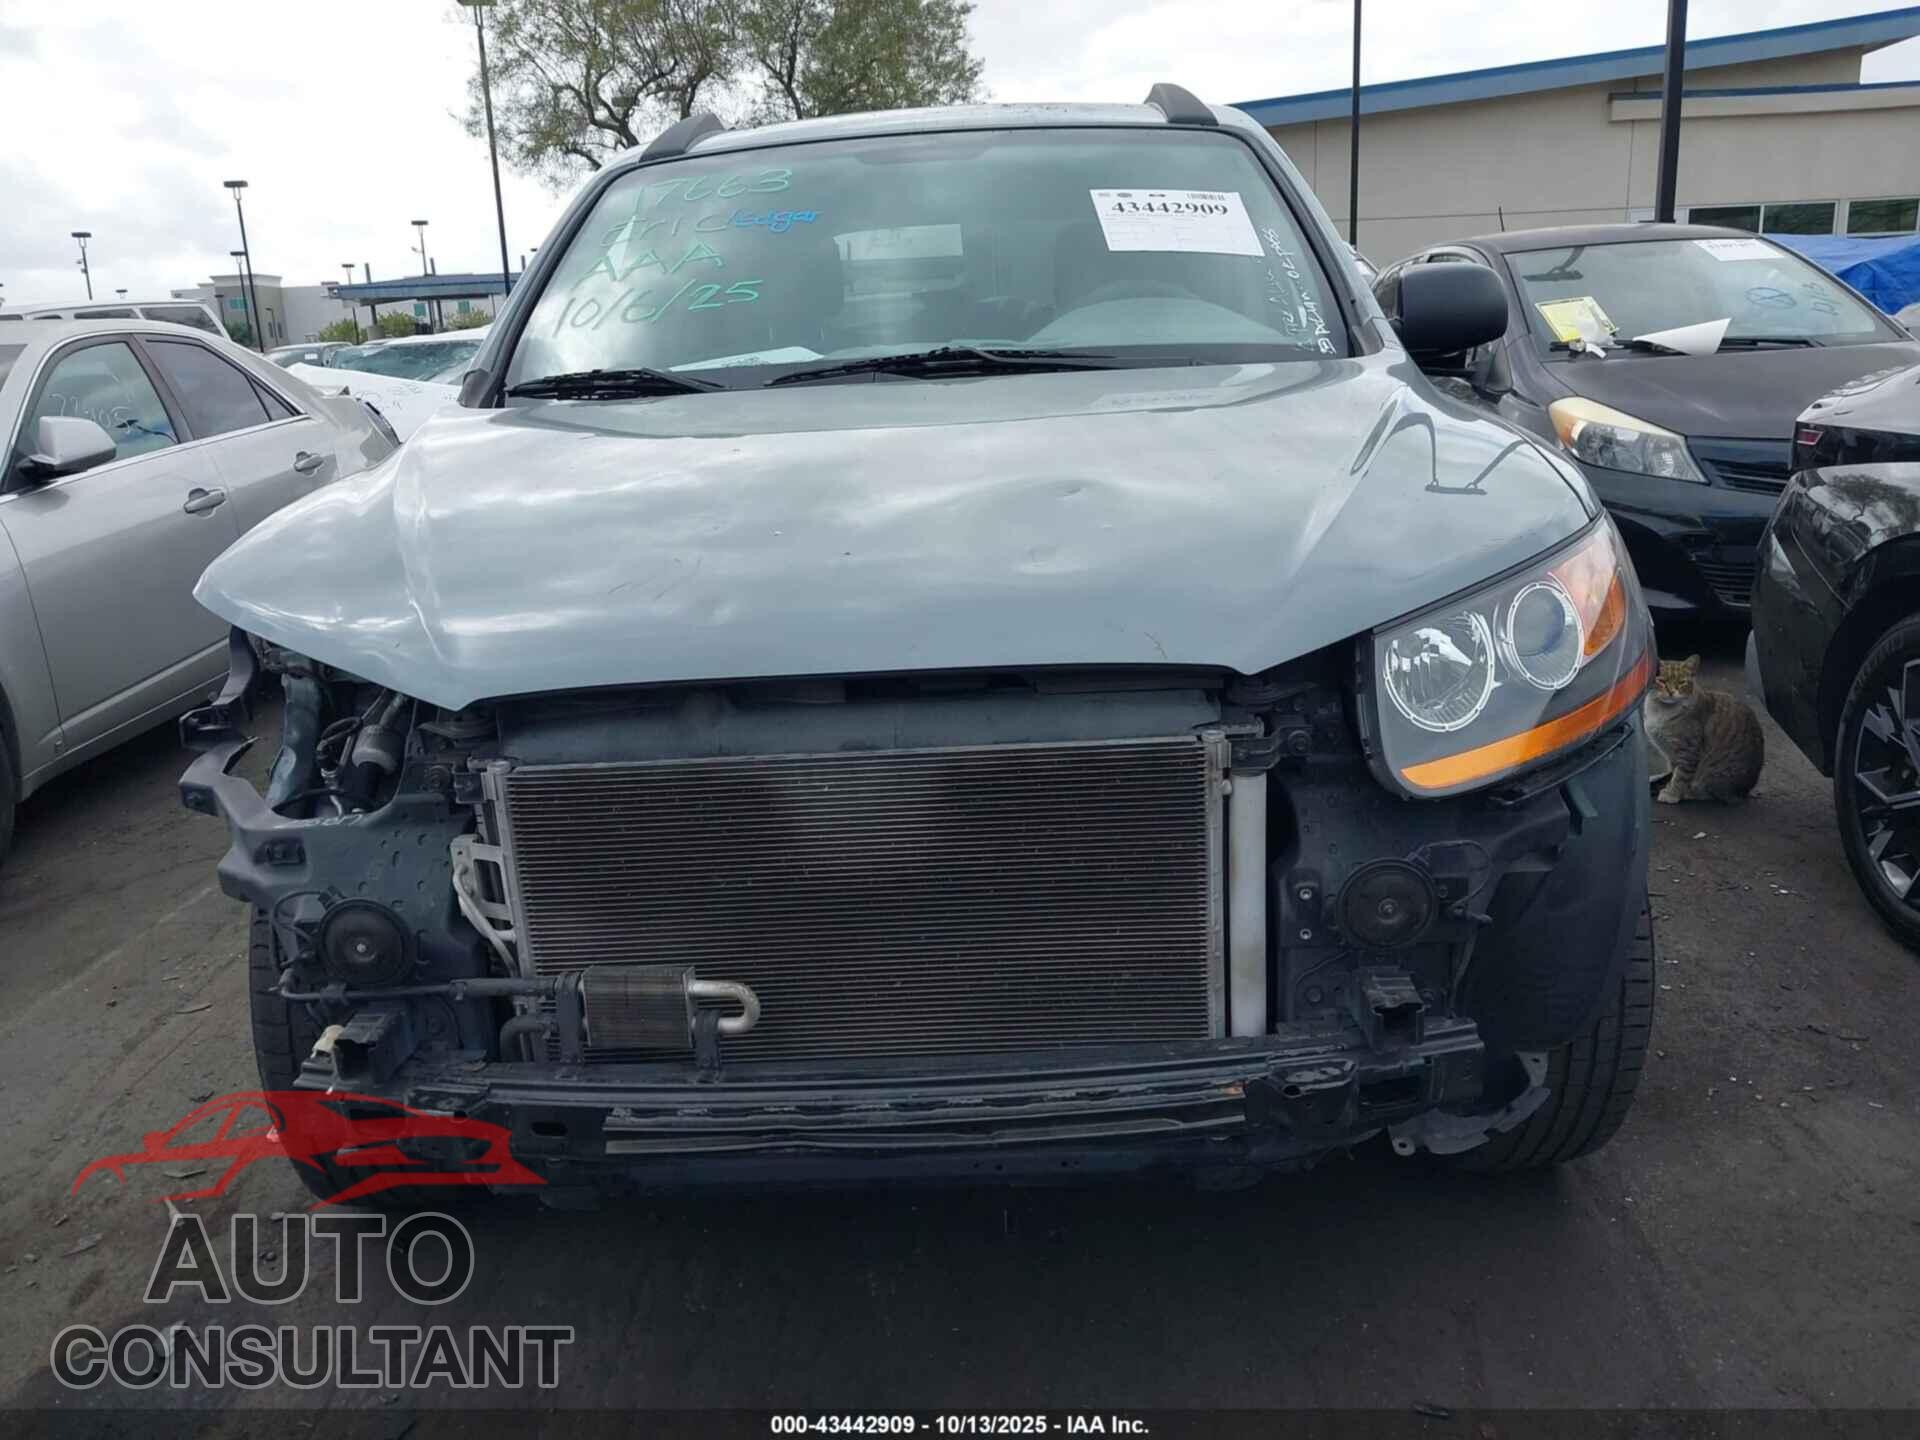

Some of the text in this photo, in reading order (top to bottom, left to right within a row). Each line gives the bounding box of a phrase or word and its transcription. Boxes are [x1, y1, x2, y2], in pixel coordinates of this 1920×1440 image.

[1112, 201, 1228, 216] 43442909
[577, 241, 725, 287] AAA
[554, 280, 764, 336] 10/6/25
